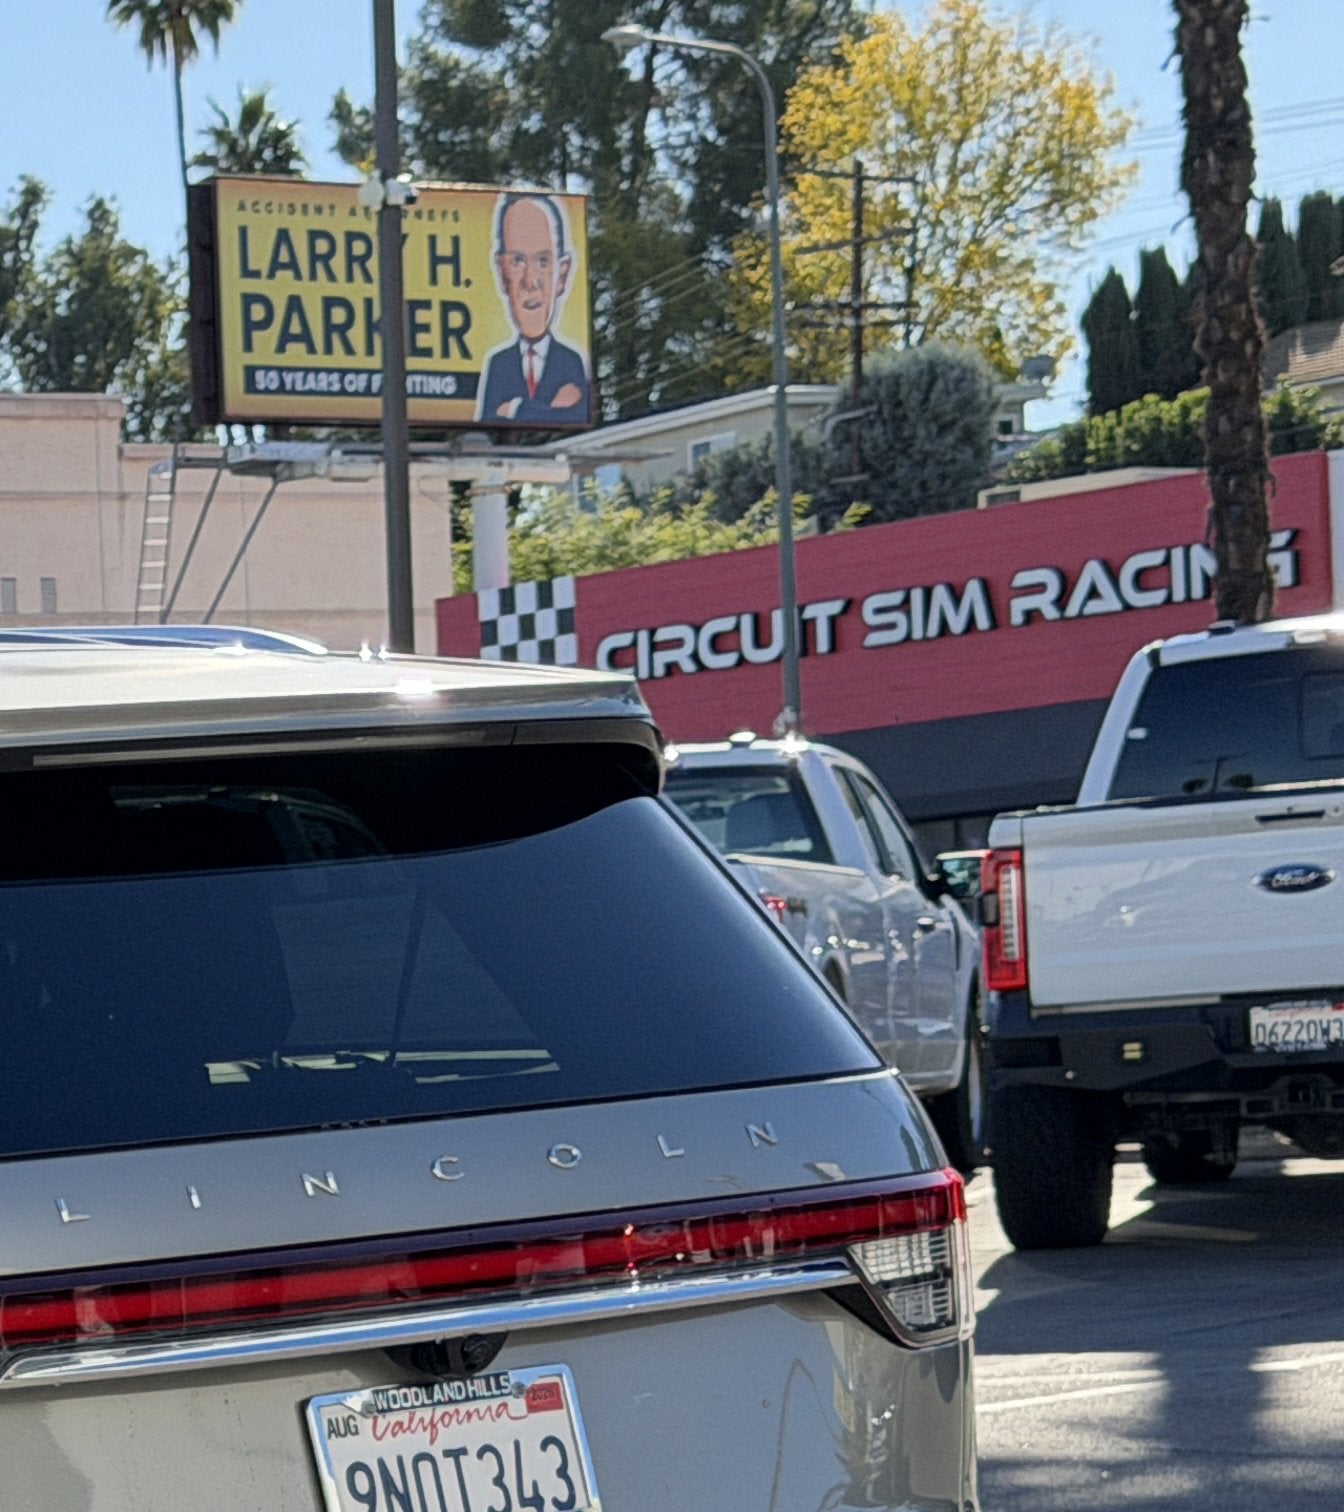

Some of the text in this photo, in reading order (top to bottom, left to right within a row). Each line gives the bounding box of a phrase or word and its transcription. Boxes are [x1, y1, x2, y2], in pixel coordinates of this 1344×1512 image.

[236, 200, 336, 217] ACCIDENT
[427, 234, 472, 288] H.
[254, 369, 279, 391] 50
[282, 371, 341, 392] YEARS
[344, 373, 369, 393] OF
[862, 577, 996, 648] SIM
[54, 1121, 779, 1222] LINCOLN
[374, 1373, 511, 1412] WOODLAND HILLS
[327, 1415, 360, 1440] AUG
[372, 1401, 529, 1446] California
